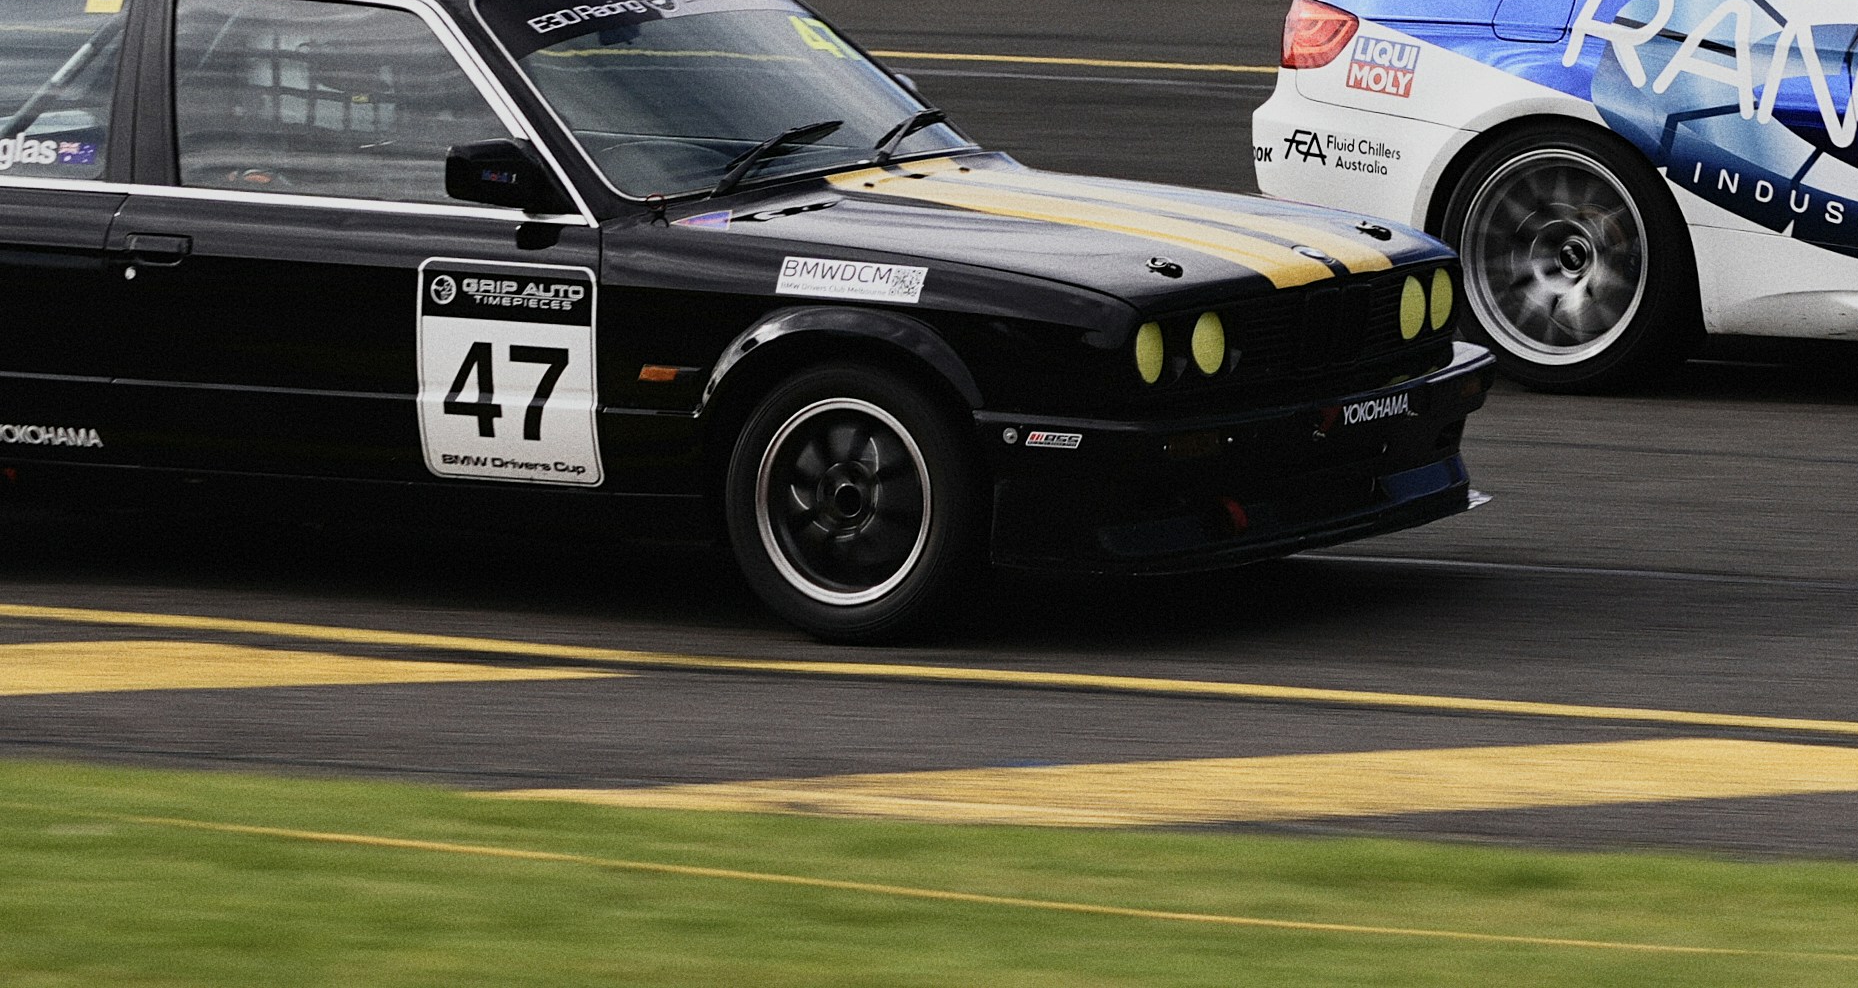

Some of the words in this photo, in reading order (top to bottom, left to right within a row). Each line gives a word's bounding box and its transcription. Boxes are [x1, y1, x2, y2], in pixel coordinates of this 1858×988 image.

[526, 8, 582, 34] E30
[573, 0, 648, 21] Racing
[1353, 36, 1420, 70] LIQUI
[1348, 62, 1415, 96] MOLY
[1326, 134, 1355, 153] Fluid
[1358, 139, 1402, 161] Chillers
[1335, 155, 1388, 176] Australia
[783, 259, 894, 285] BMWDCM
[462, 277, 519, 296] GRIP
[522, 281, 586, 301] AUTO
[473, 294, 573, 311] TIMEPIECES
[443, 341, 570, 442] 47
[1342, 392, 1409, 426] YOKOHAMA
[441, 453, 489, 467] BMW
[490, 457, 552, 472] Drivers
[553, 461, 587, 476] Cup
